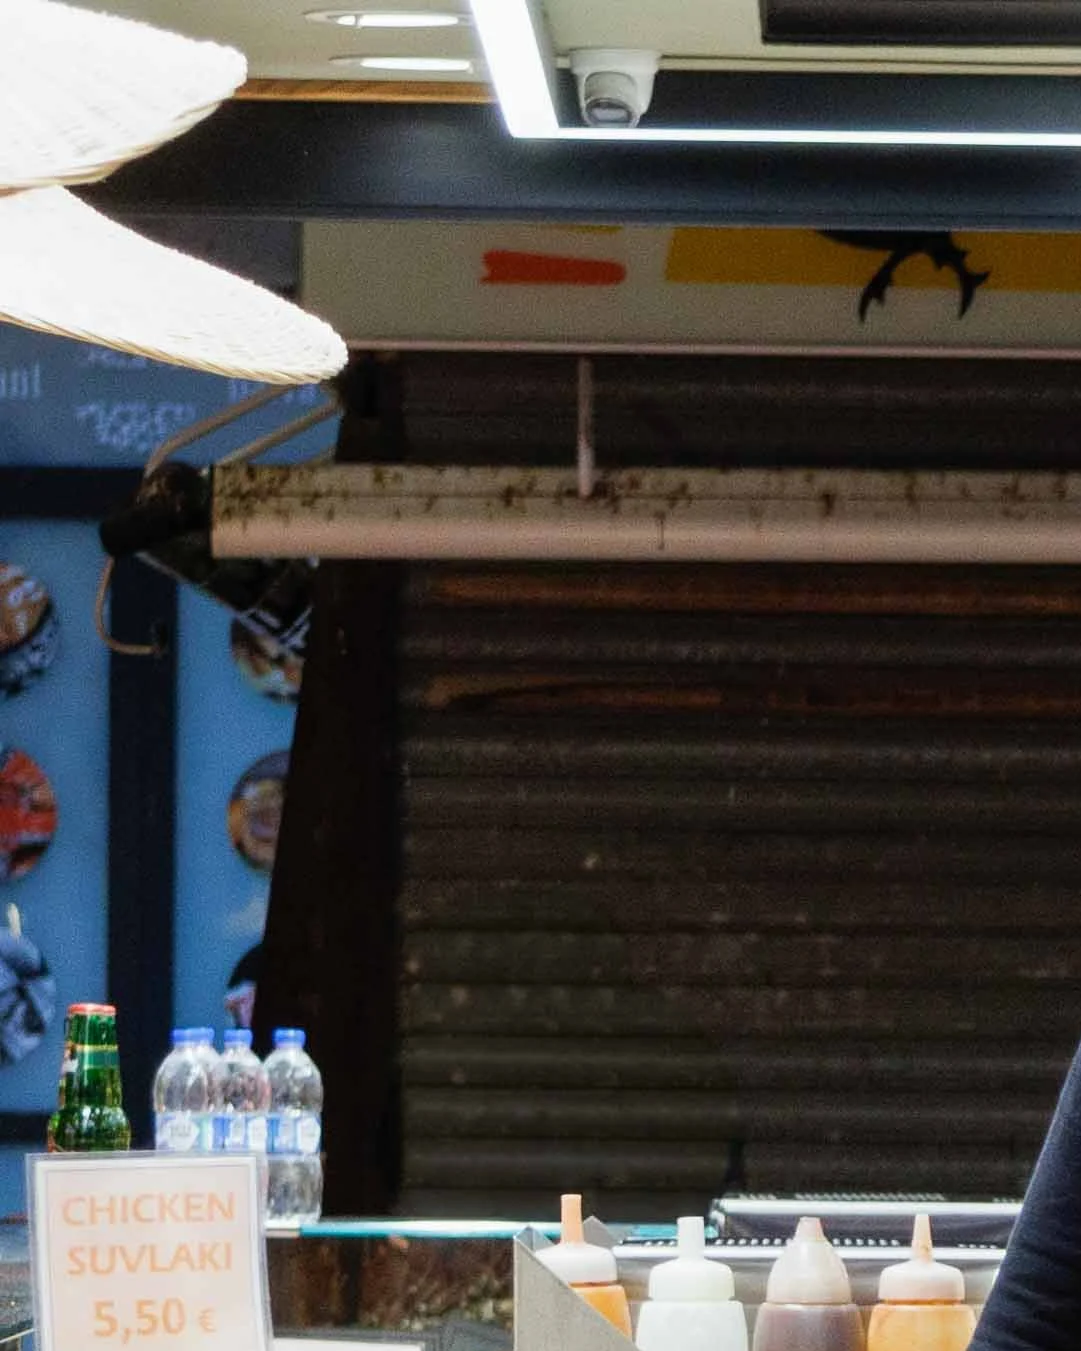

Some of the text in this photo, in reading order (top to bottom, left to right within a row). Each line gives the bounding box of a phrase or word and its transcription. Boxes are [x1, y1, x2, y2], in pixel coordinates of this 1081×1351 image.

[61, 1191, 235, 1226] CHICKEN
[66, 1242, 233, 1276] SUVLAKI
[92, 1298, 217, 1344] 5,50 €
